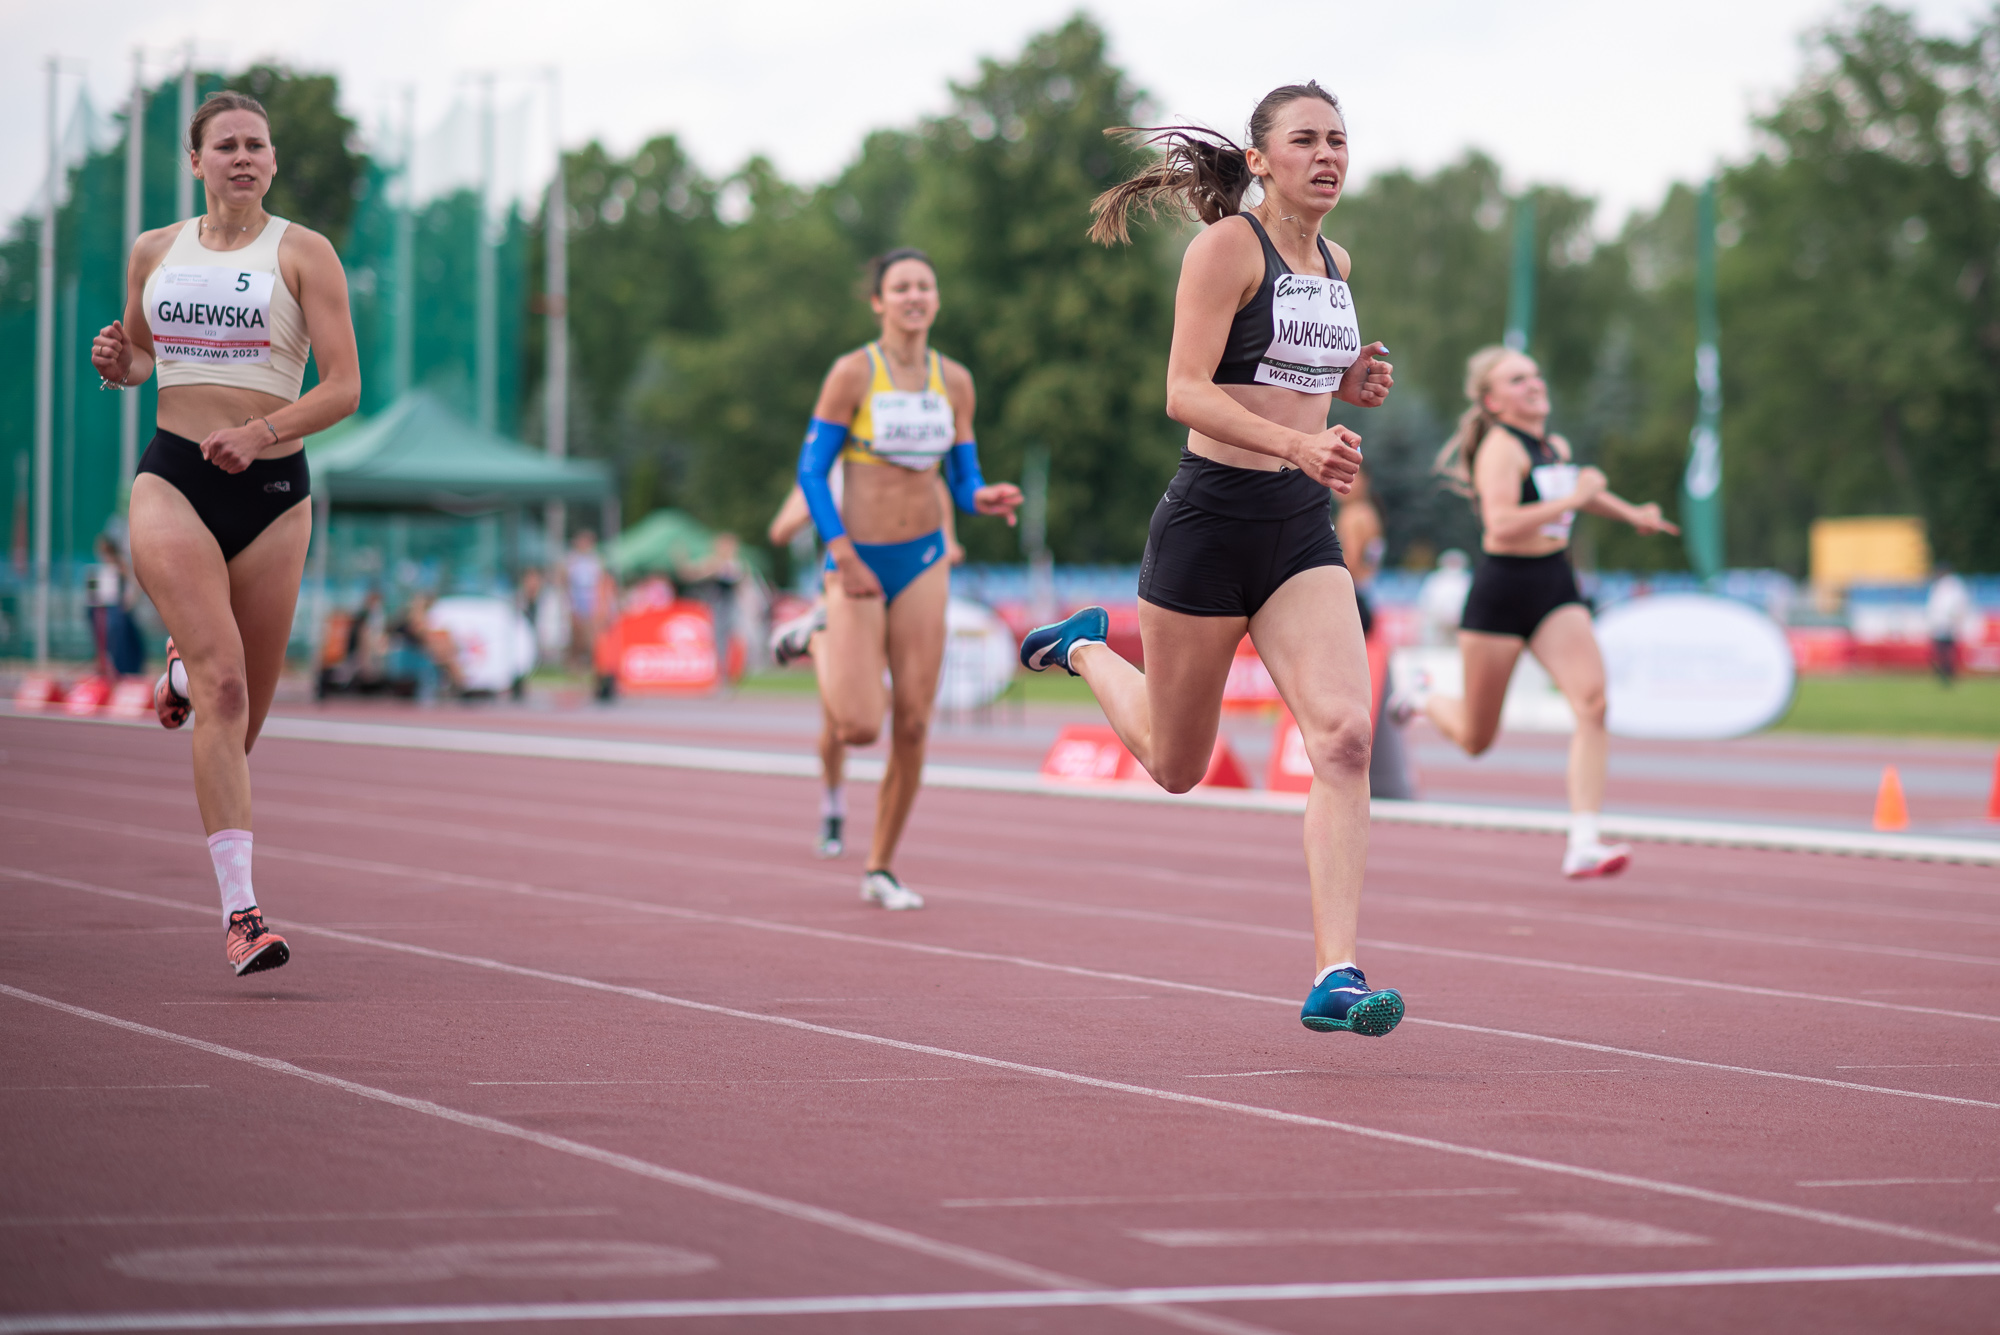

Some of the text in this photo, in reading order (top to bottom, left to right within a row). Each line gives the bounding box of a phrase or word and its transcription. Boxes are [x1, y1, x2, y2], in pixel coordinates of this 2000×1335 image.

[235, 272, 252, 292] 5
[1329, 283, 1347, 309] 83
[158, 301, 265, 329] GAJEWSKA
[204, 329, 217, 337] U23
[1277, 318, 1358, 352] MUKHOBROD
[164, 345, 259, 358] WARSZAWA 2023
[1269, 368, 1324, 388] WARSZAWA
